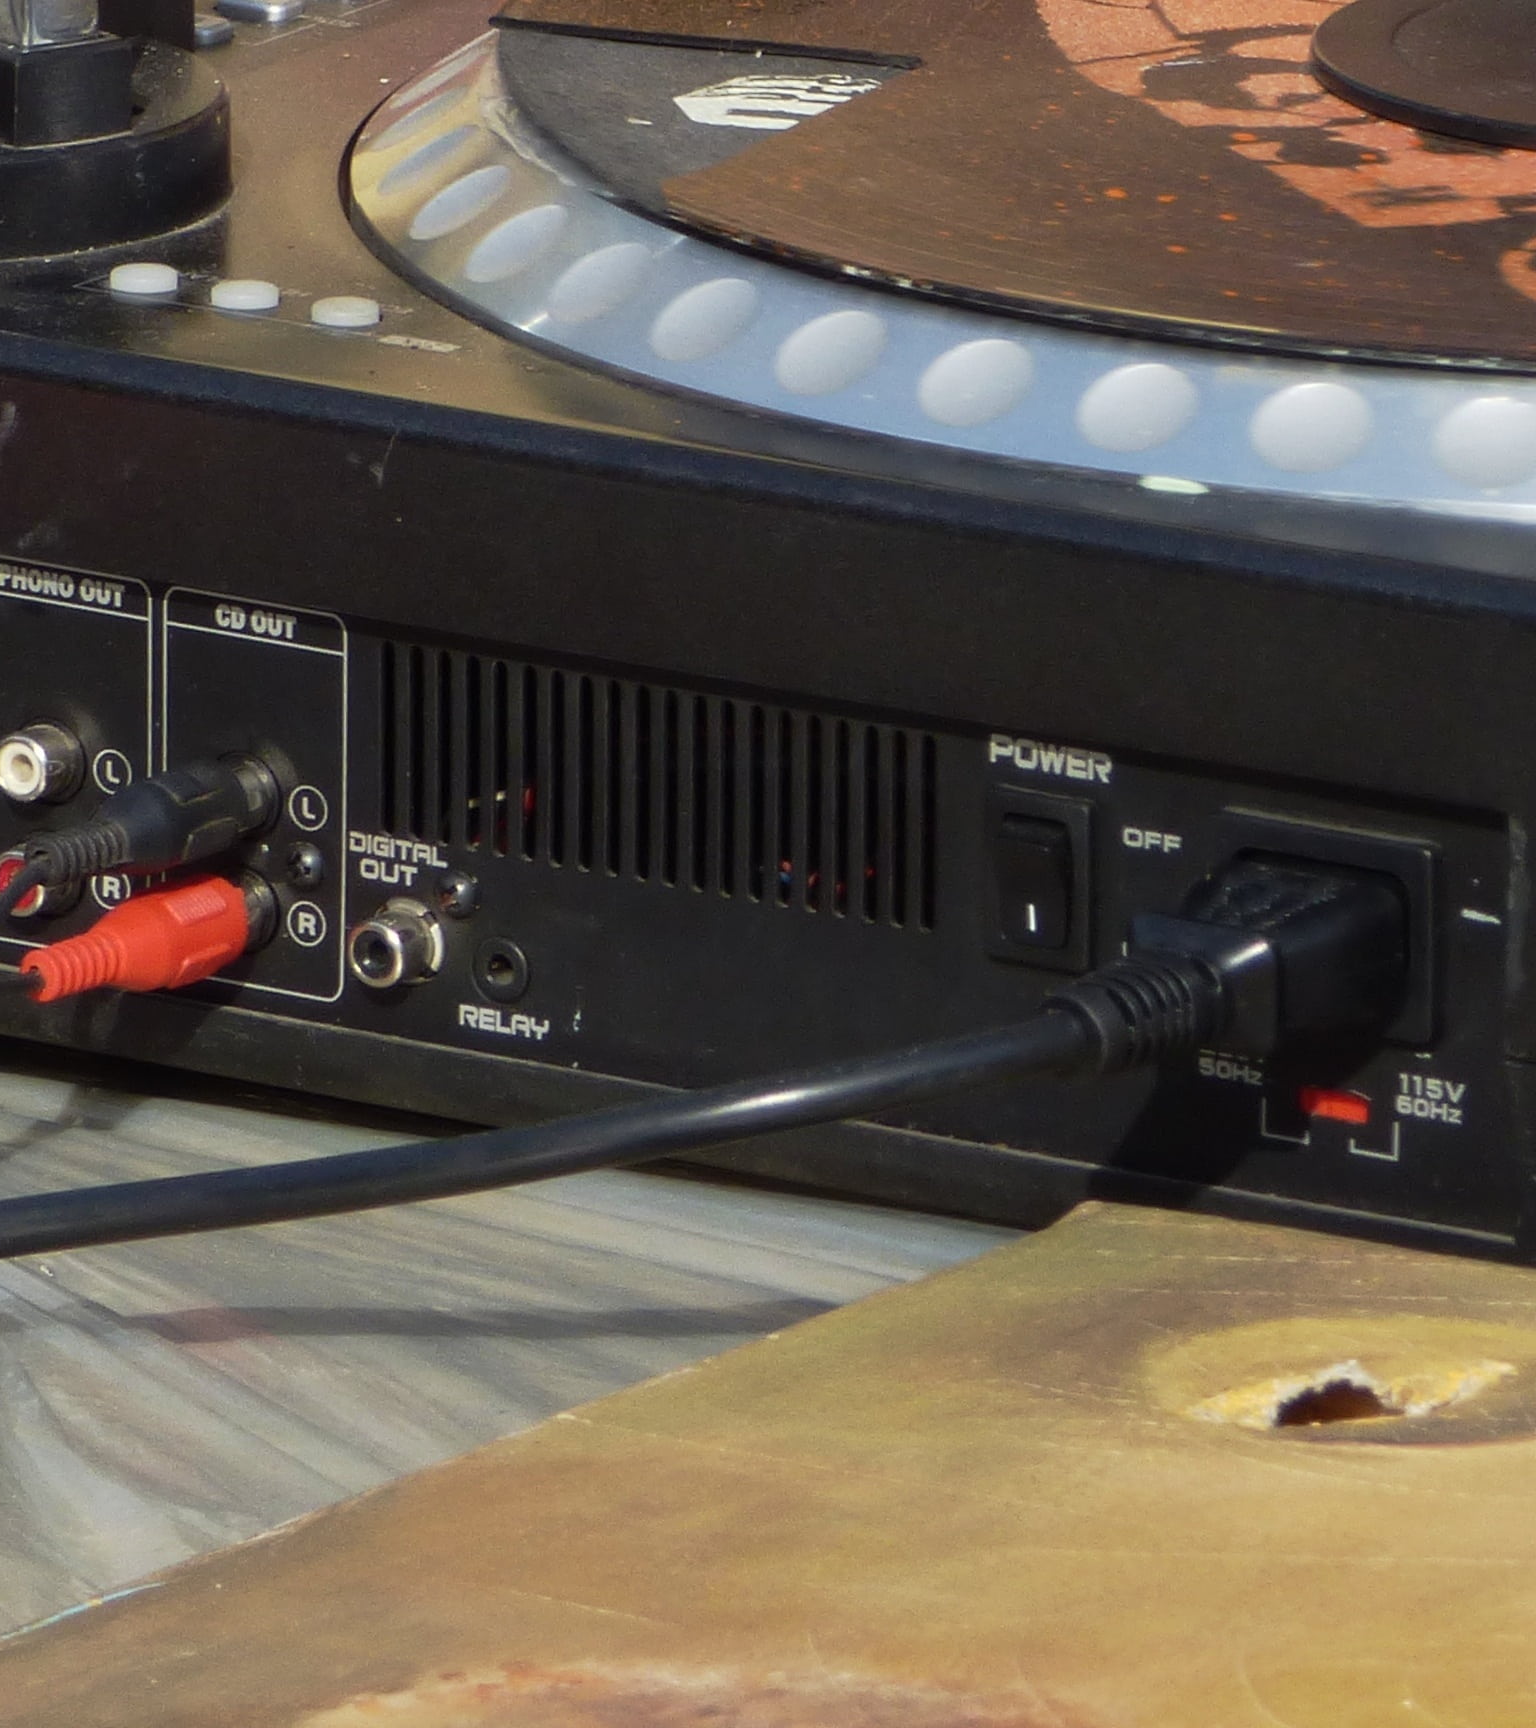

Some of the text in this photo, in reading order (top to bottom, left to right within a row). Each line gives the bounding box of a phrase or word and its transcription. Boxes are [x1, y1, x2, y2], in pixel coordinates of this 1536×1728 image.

[79, 577, 126, 607] OUT
[214, 603, 298, 640] CD OUT
[989, 733, 1113, 784] POWER
[301, 796, 316, 820] L
[348, 831, 449, 869] DIGITAL
[1122, 826, 1183, 853] OFF
[359, 857, 418, 887] OUT
[297, 911, 317, 937] R
[458, 1004, 550, 1040] RELAY
[1398, 1073, 1466, 1104] 115V
[1394, 1094, 1463, 1125] 60Hz
